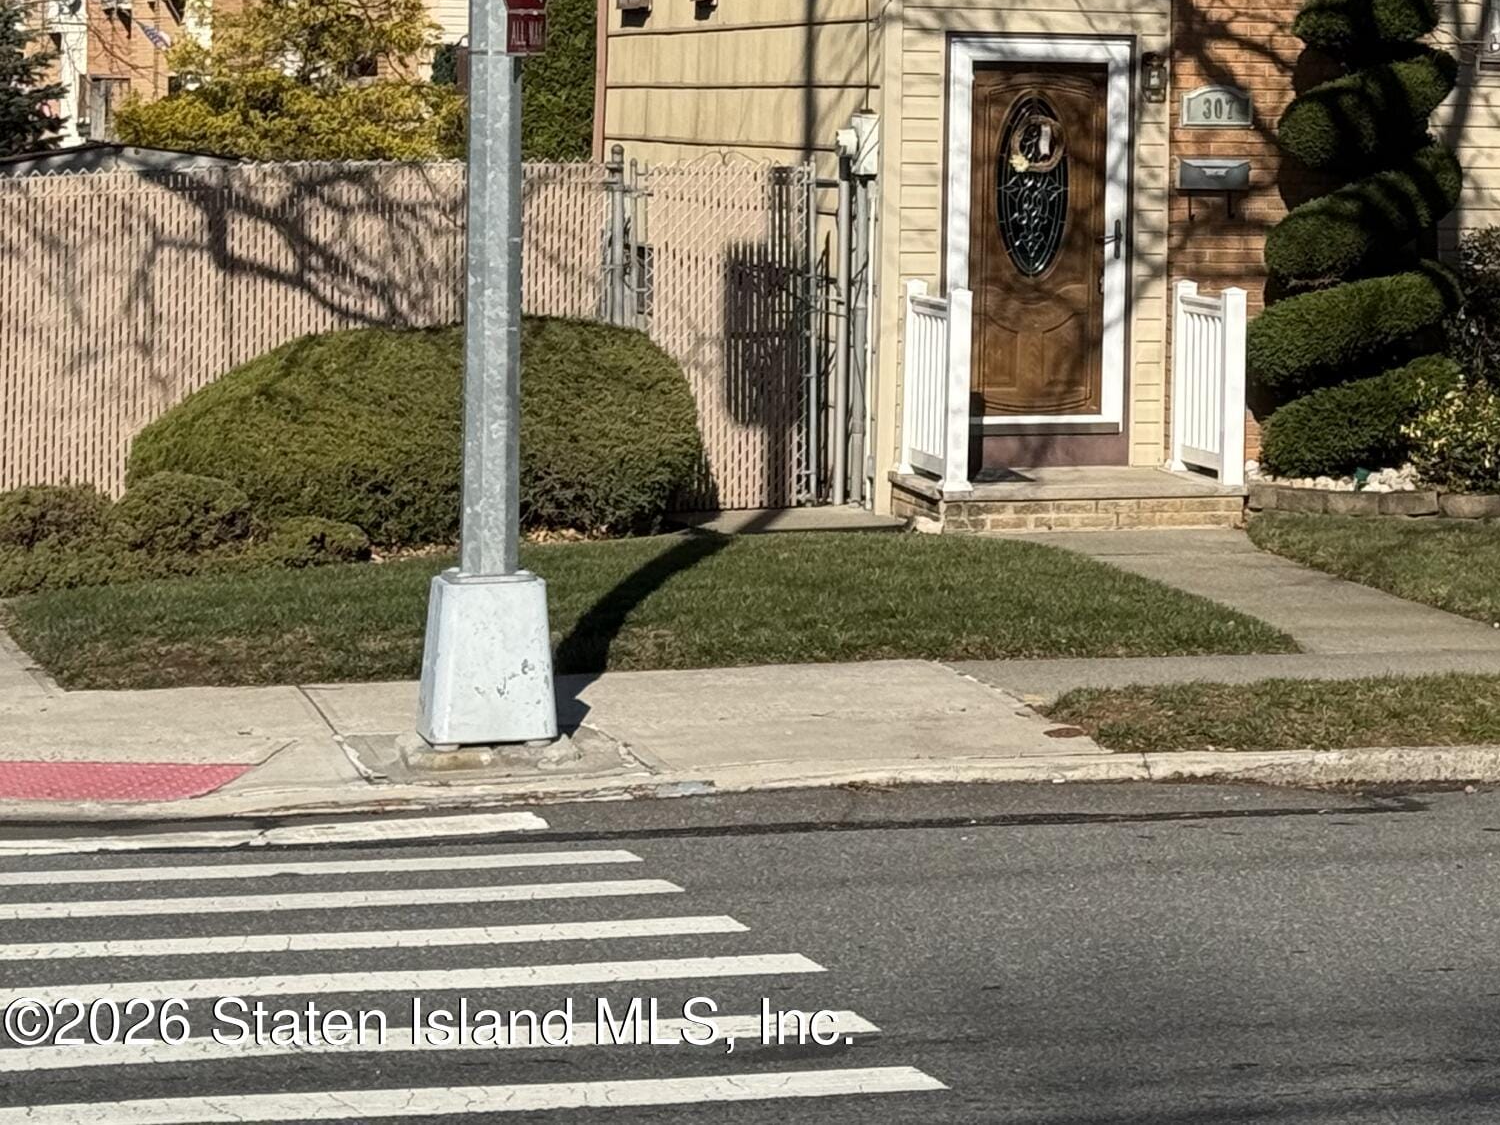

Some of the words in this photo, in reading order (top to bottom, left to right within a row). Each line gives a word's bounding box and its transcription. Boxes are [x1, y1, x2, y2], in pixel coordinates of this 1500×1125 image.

[510, 20, 527, 45] ALL
[528, 20, 544, 45] WAY
[1202, 97, 1235, 120] 307
